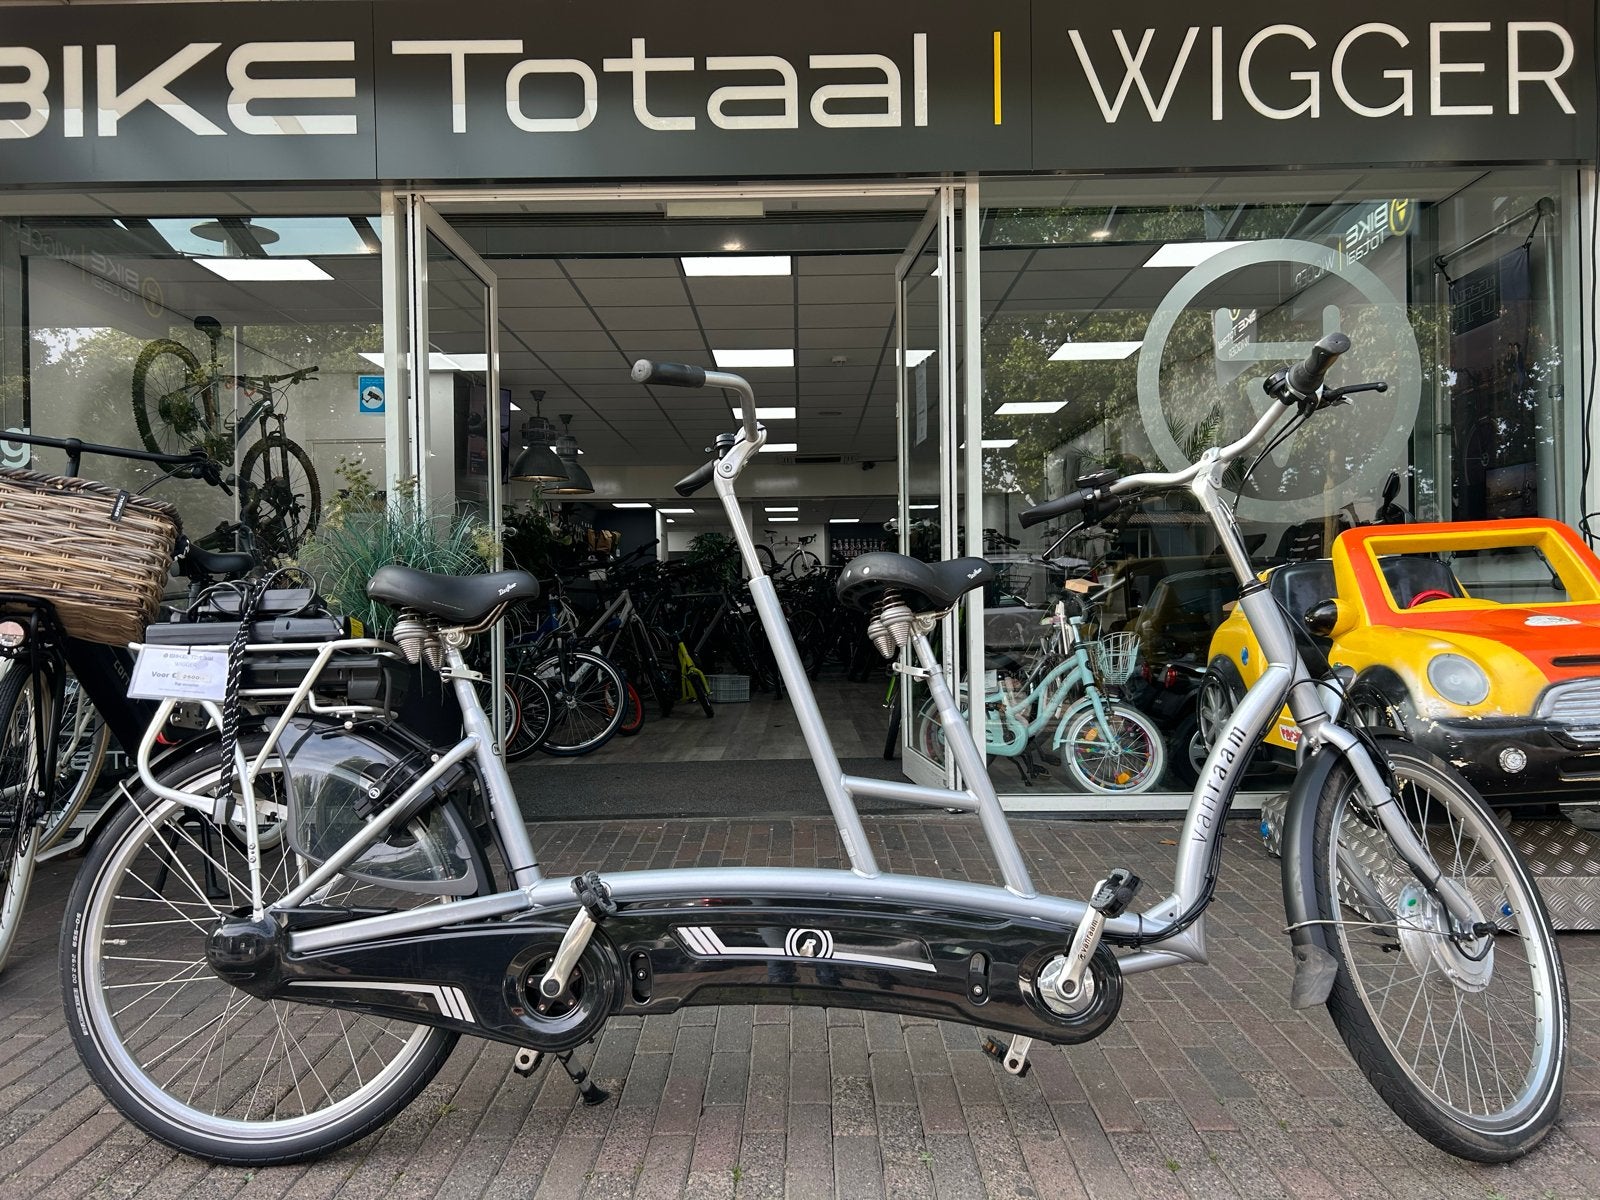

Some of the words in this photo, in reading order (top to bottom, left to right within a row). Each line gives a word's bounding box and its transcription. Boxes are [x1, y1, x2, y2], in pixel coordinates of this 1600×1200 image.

[0, 41, 358, 138] BIKE
[391, 33, 928, 133] Totaal
[1067, 21, 1576, 123] WIGGER
[151, 671, 170, 679] Voor
